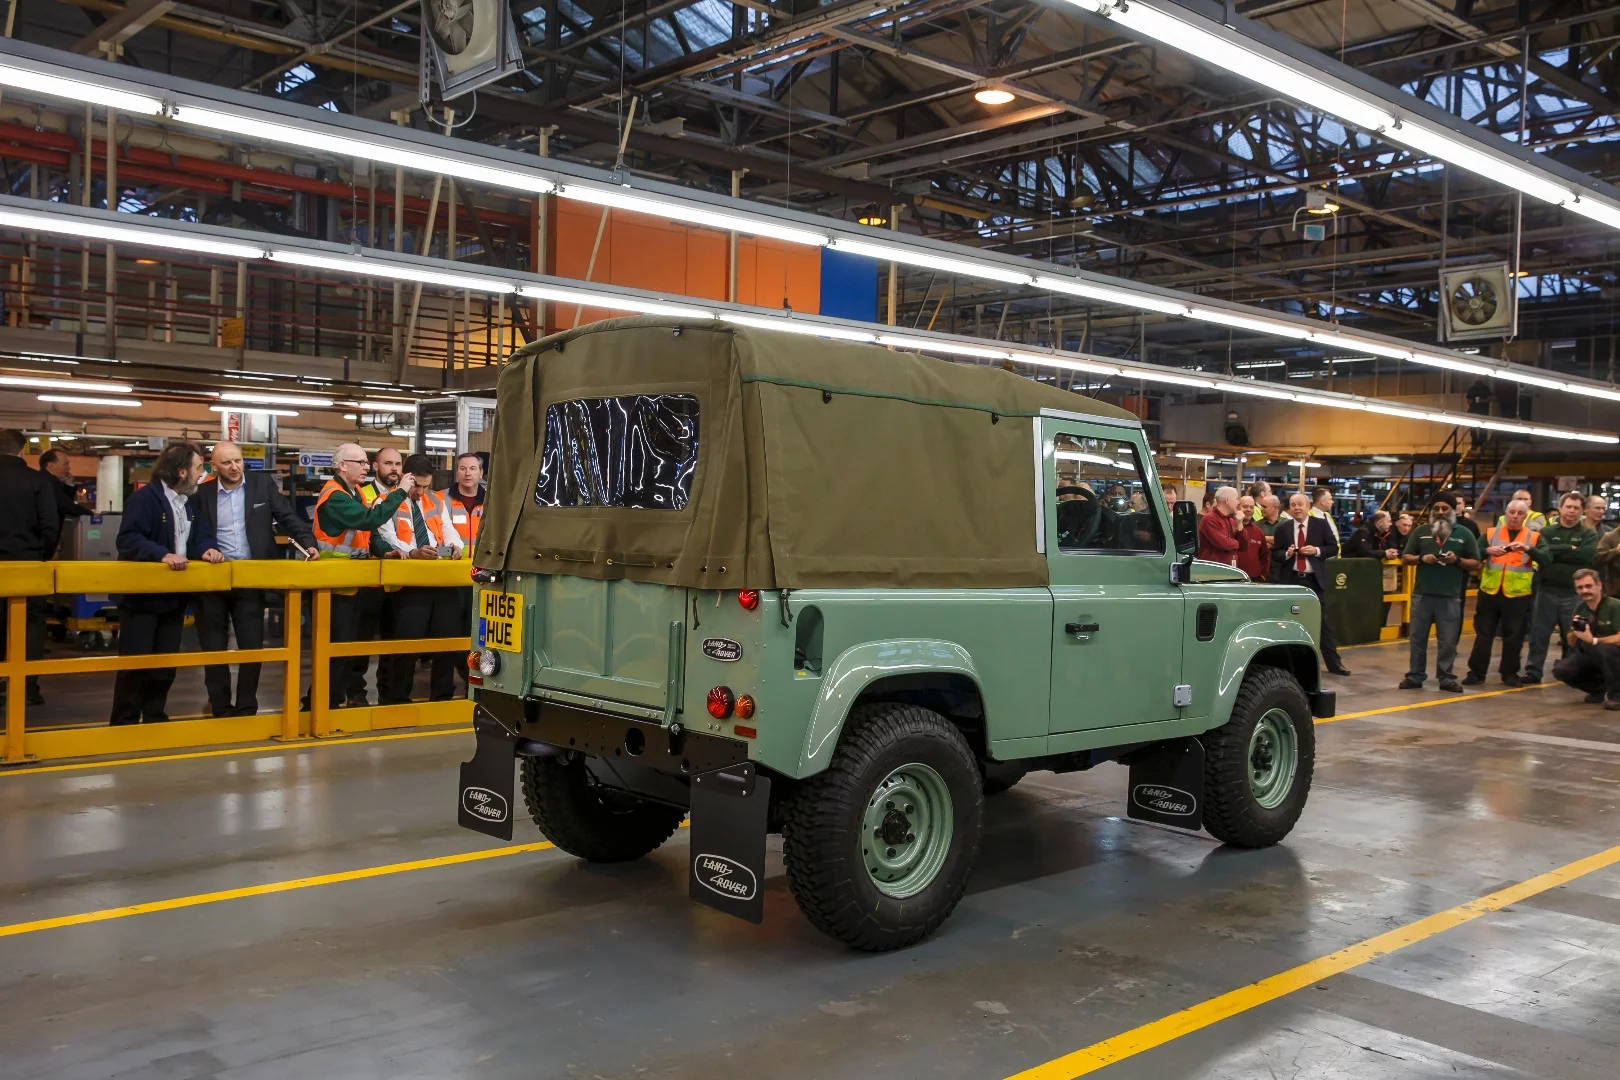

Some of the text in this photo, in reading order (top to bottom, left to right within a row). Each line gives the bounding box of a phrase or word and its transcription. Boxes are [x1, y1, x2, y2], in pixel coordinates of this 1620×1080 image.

[486, 620, 513, 646] HUE
[706, 640, 725, 649] LAND
[715, 650, 736, 659] ROVER
[469, 790, 489, 802] LAND
[1141, 787, 1168, 798] LAND
[478, 804, 502, 819] ROVER
[1155, 800, 1188, 813] ROVER
[702, 858, 729, 874] LAND
[716, 877, 749, 896] ROVER
